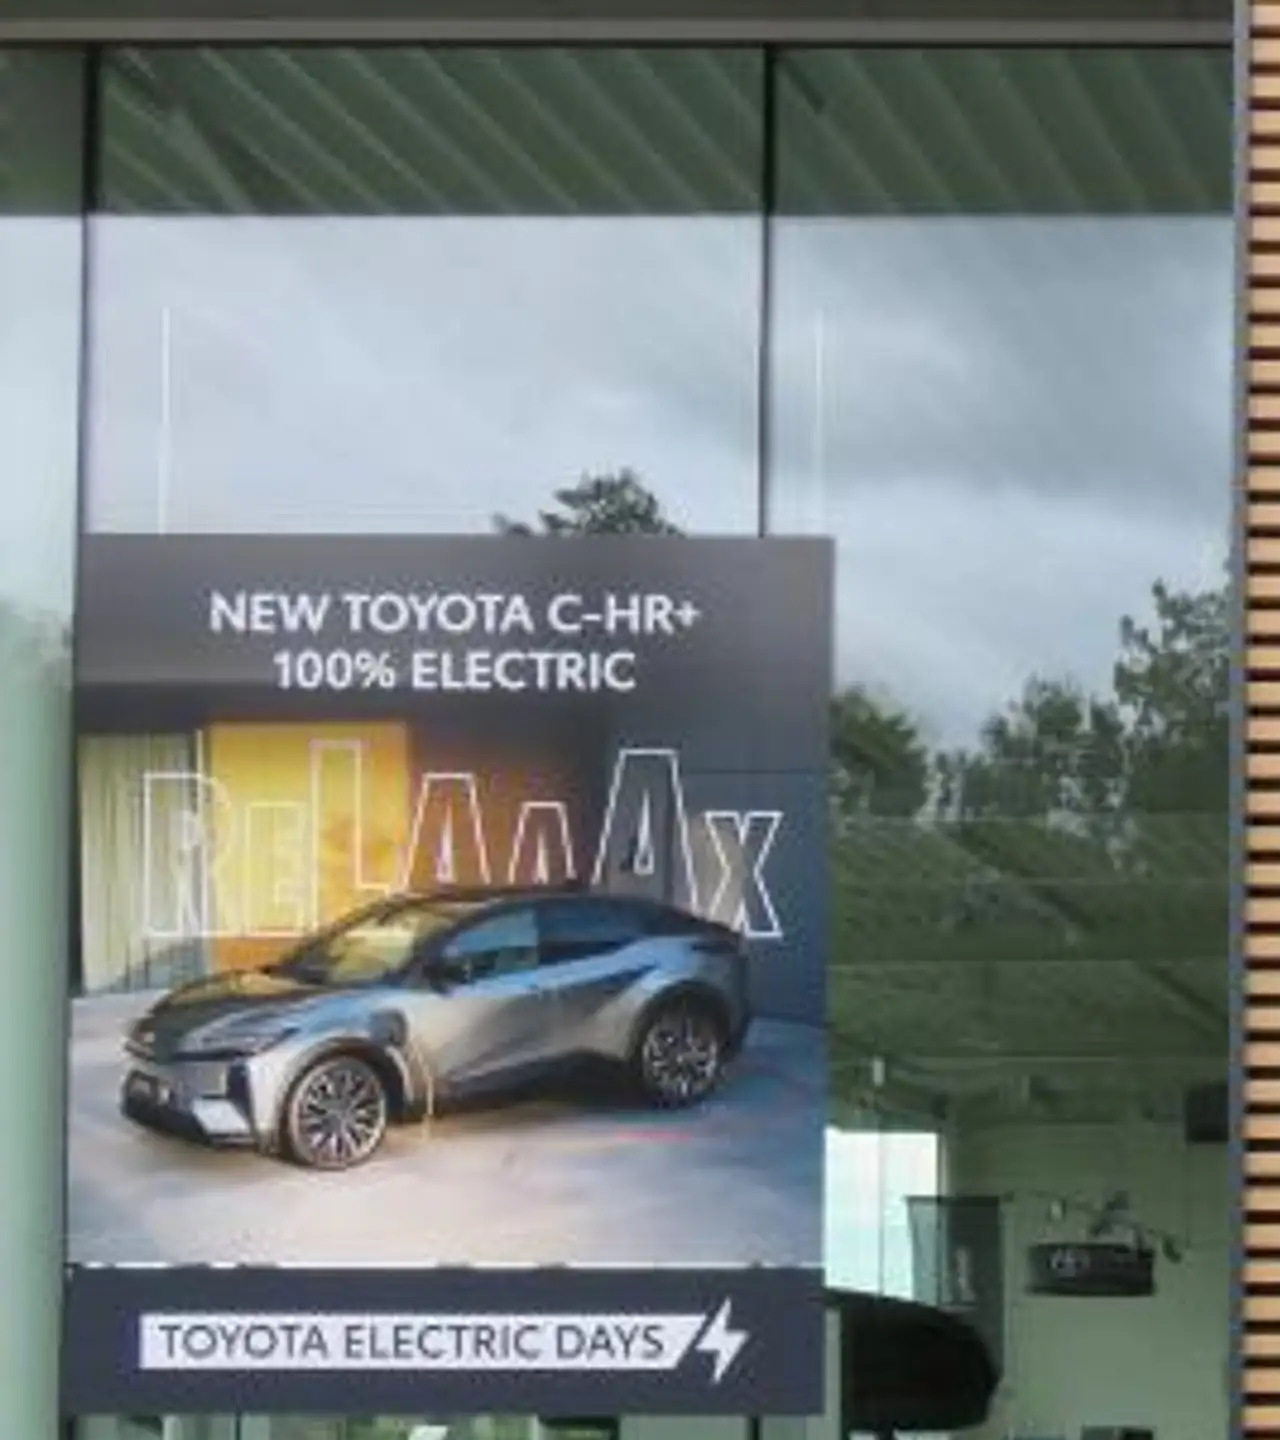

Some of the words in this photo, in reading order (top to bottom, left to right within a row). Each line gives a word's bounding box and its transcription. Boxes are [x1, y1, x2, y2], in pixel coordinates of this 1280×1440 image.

[209, 594, 328, 633] NEW
[343, 594, 535, 634] TOYOTA
[547, 594, 702, 634] C-HR+
[273, 650, 396, 690] 100%
[413, 650, 636, 690] ELECTRIC
[158, 1325, 327, 1359] TOYOTA
[345, 1325, 545, 1359] ELECTRIC
[556, 1325, 664, 1359] DAYS
